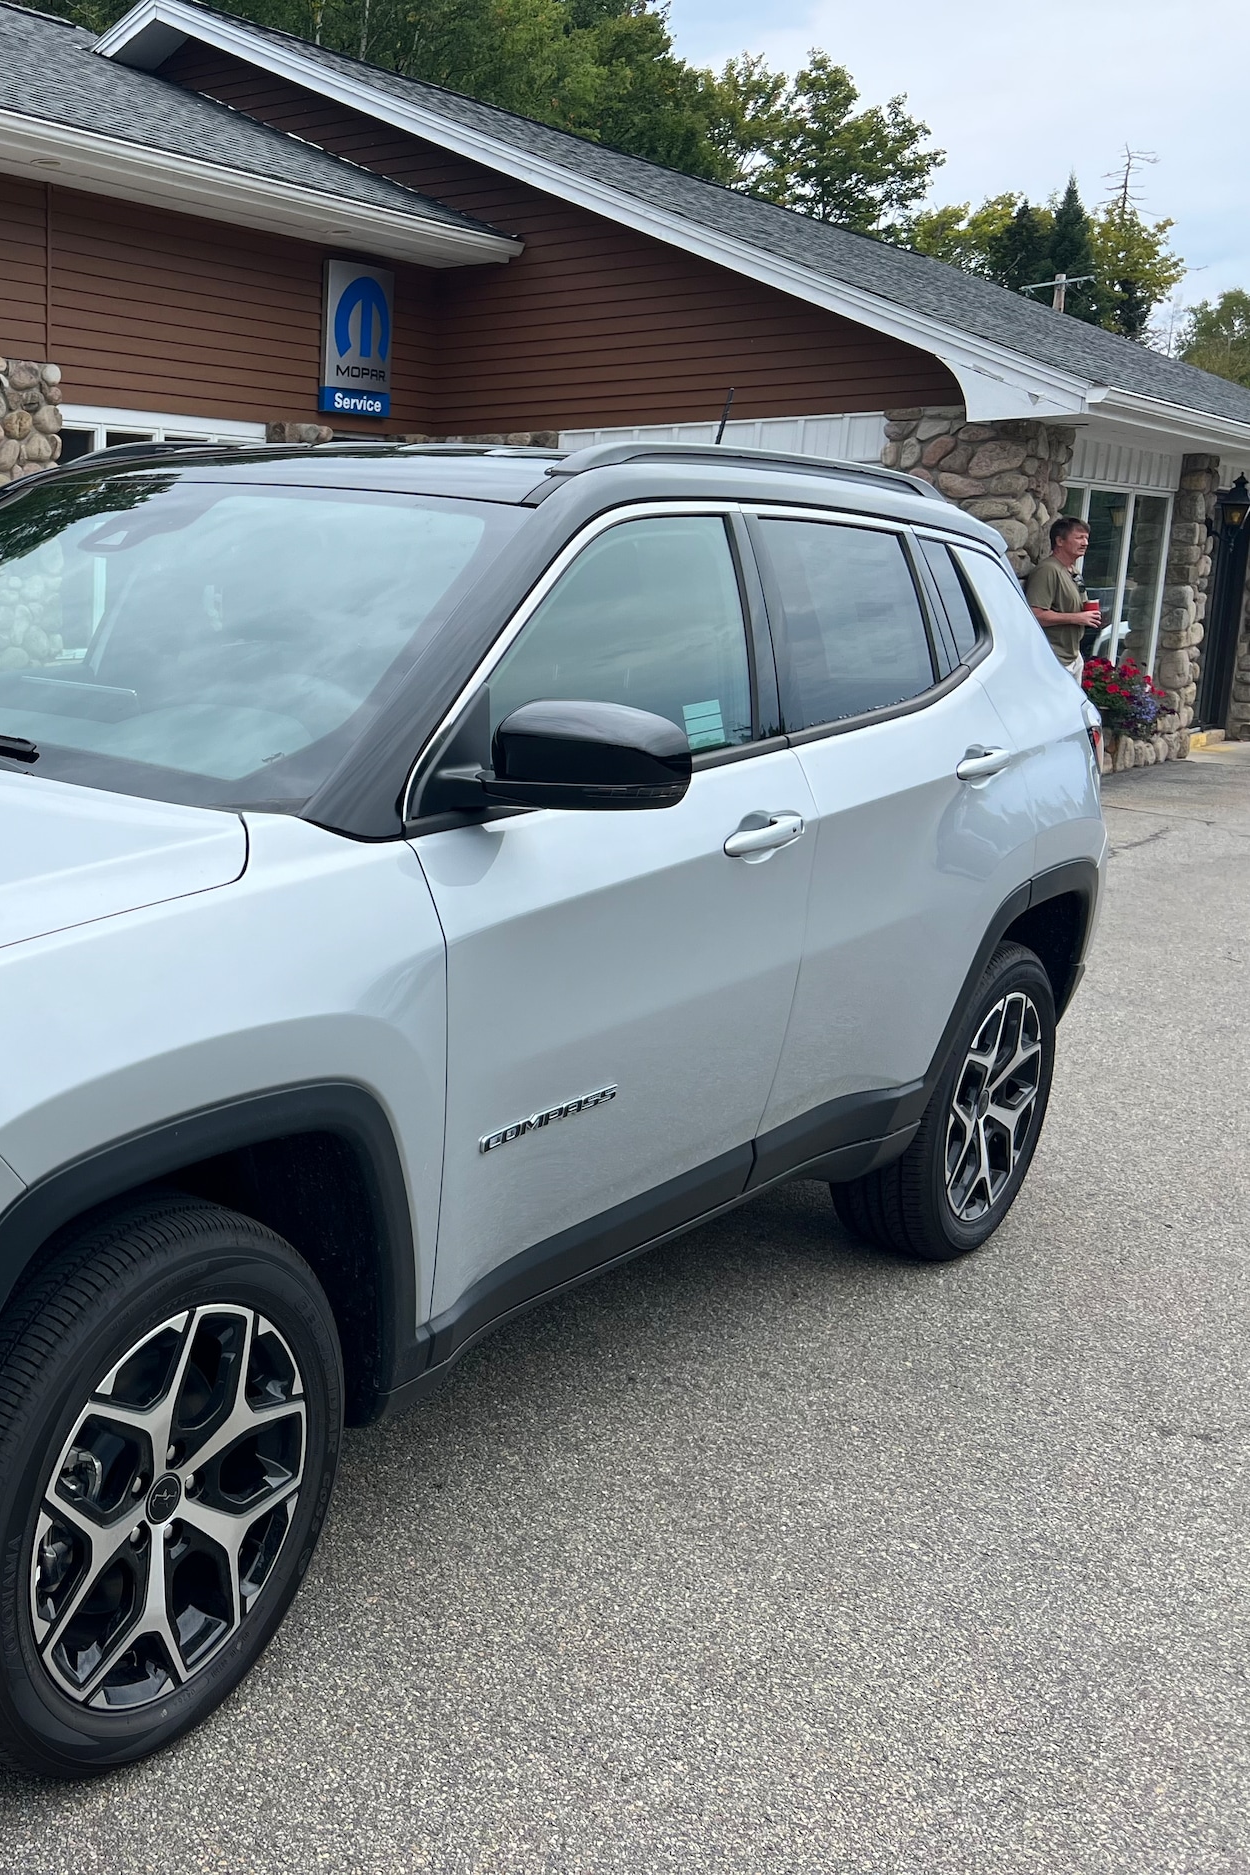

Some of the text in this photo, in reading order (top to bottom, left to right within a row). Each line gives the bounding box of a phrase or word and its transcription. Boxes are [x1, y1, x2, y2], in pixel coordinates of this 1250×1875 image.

[335, 364, 387, 383] MOPAR
[333, 392, 383, 413] Service
[478, 1083, 618, 1153] COMPASS
